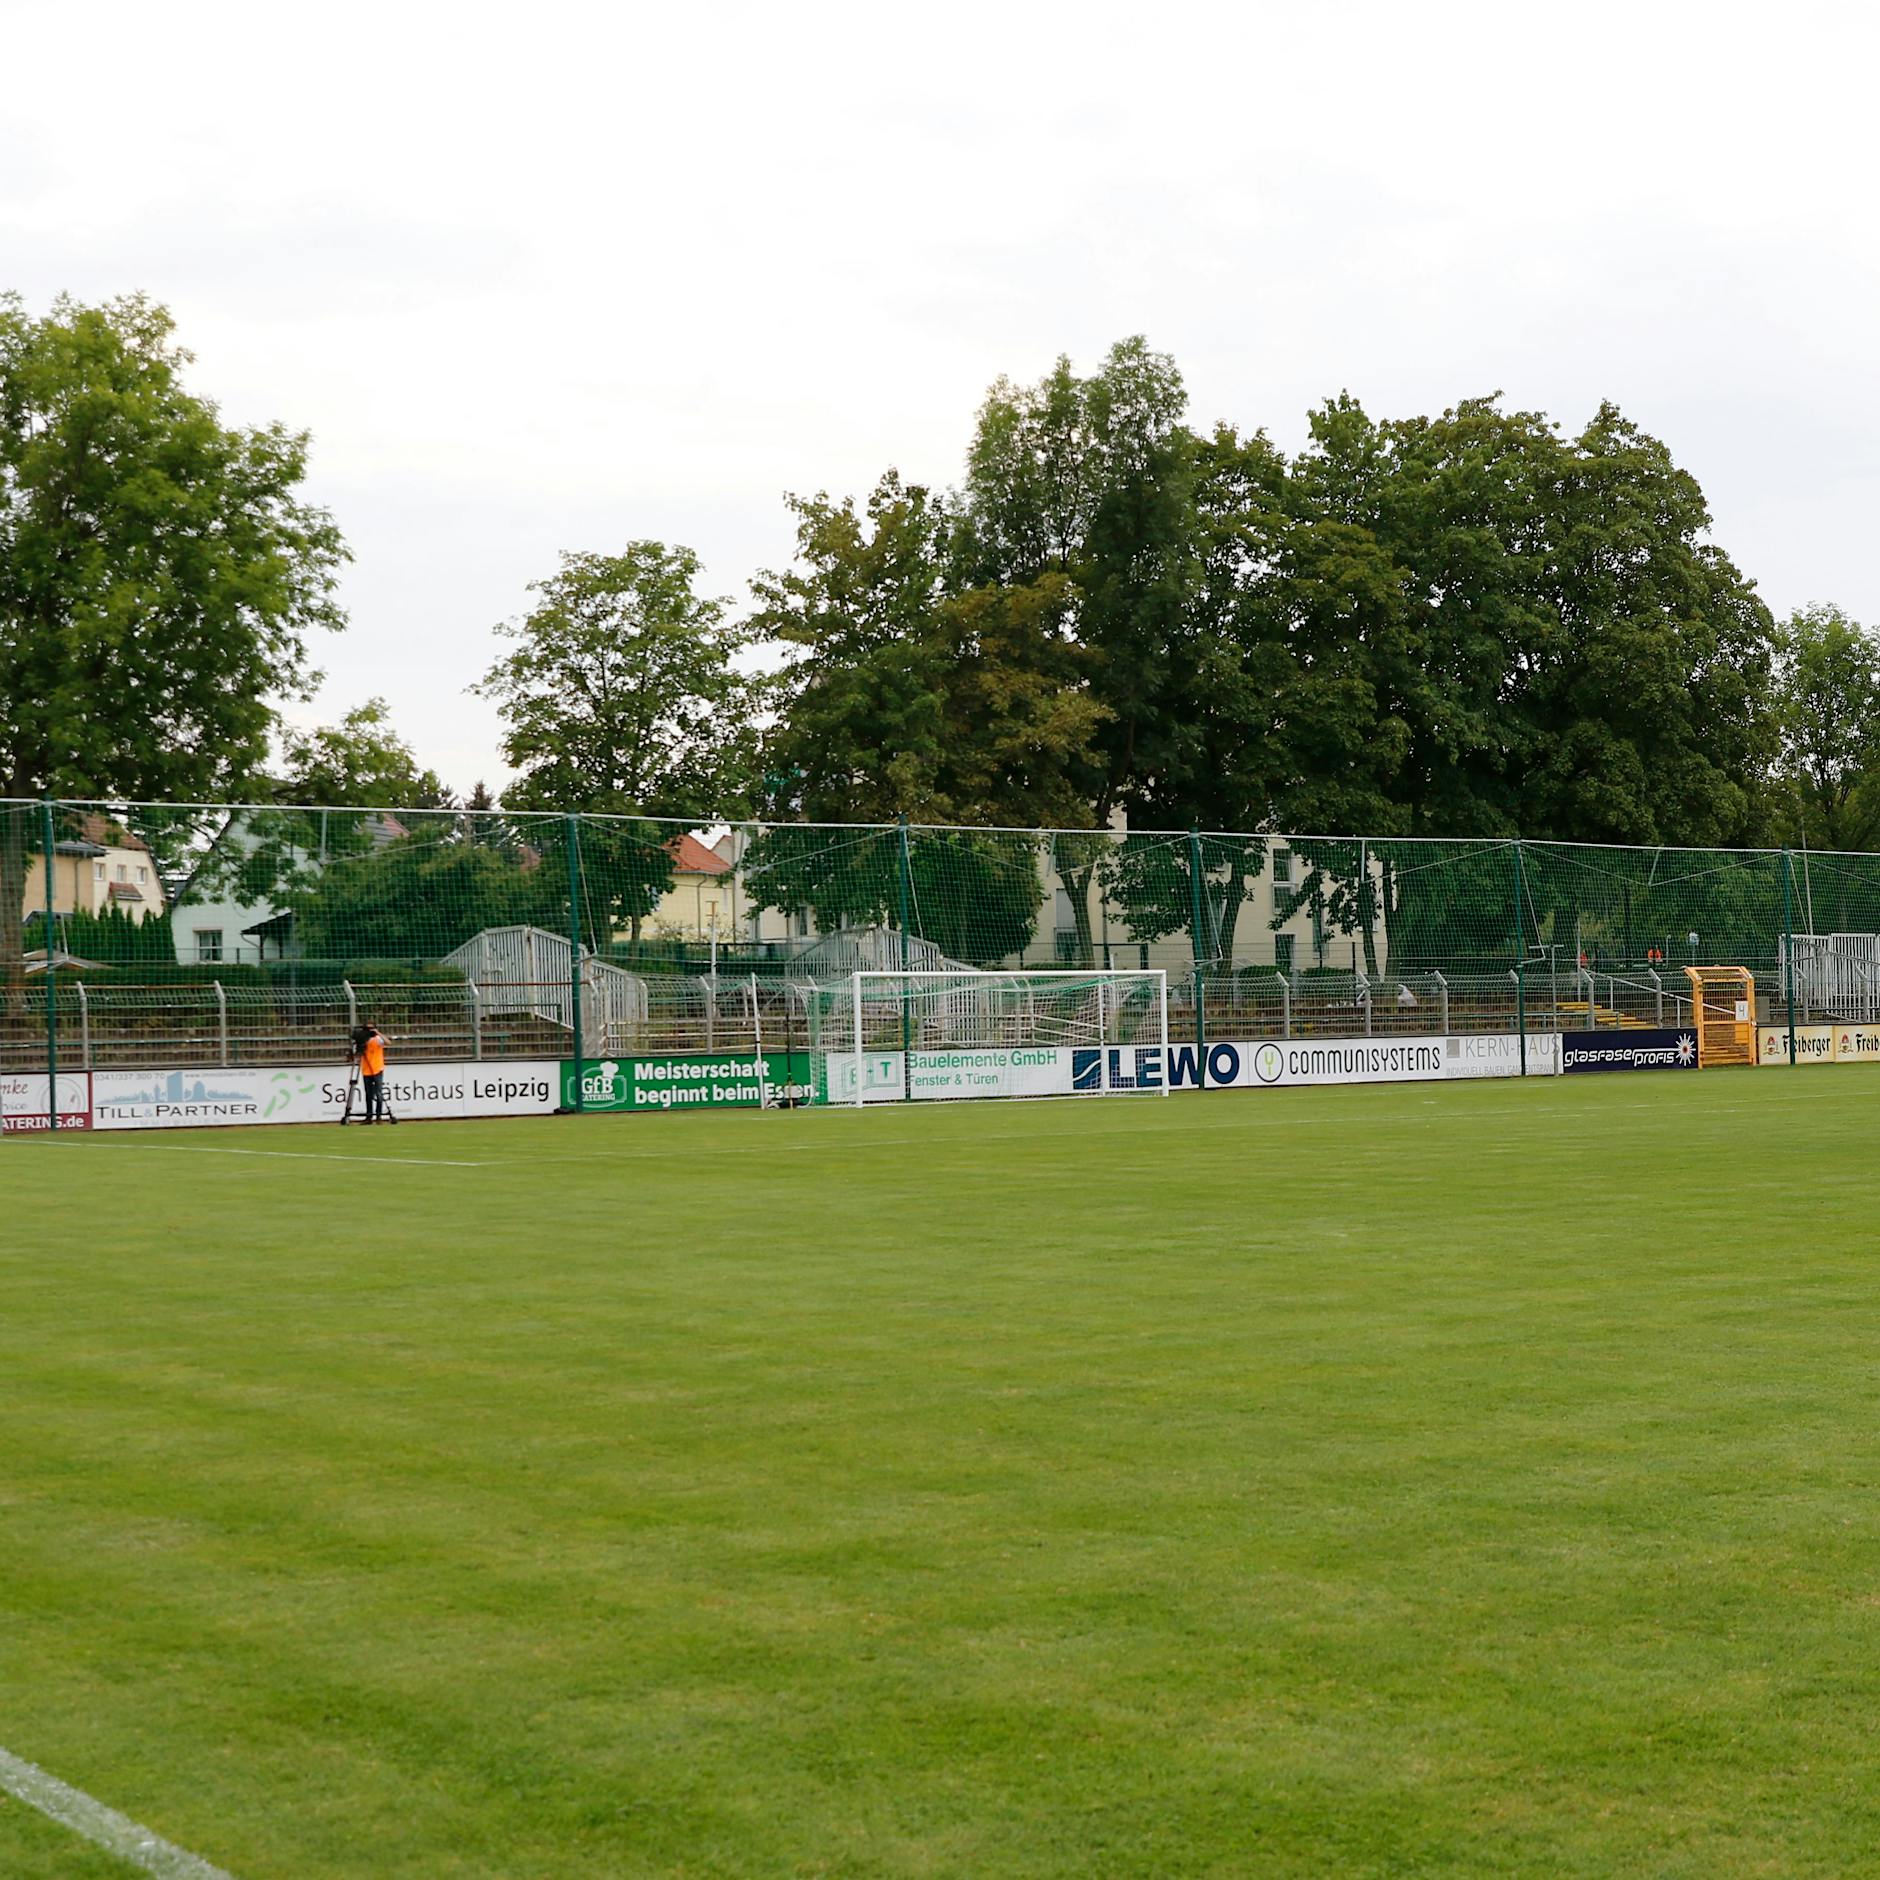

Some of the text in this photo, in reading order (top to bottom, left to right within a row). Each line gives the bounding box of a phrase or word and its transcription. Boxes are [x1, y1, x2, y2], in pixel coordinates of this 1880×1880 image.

[1782, 1035, 1831, 1057] Feiberger
[1855, 1033, 1880, 1052] Freib
[908, 1050, 1058, 1069] Bauelemente GmbH
[1108, 1043, 1240, 1089] LEWO
[1289, 1046, 1441, 1074] COMMUNISYSTEMS
[634, 1059, 770, 1081] Meisterschaft
[909, 1072, 998, 1087] Fenster & Türen
[322, 1077, 550, 1104] Sanätshaus Leipzig
[581, 1075, 614, 1094] GfB
[581, 1093, 616, 1102] ATERING
[634, 1083, 708, 1107] beginnt
[710, 1082, 760, 1101] beim
[156, 1103, 258, 1117] PARTNER
[2, 1114, 85, 1130] ATERING.de
